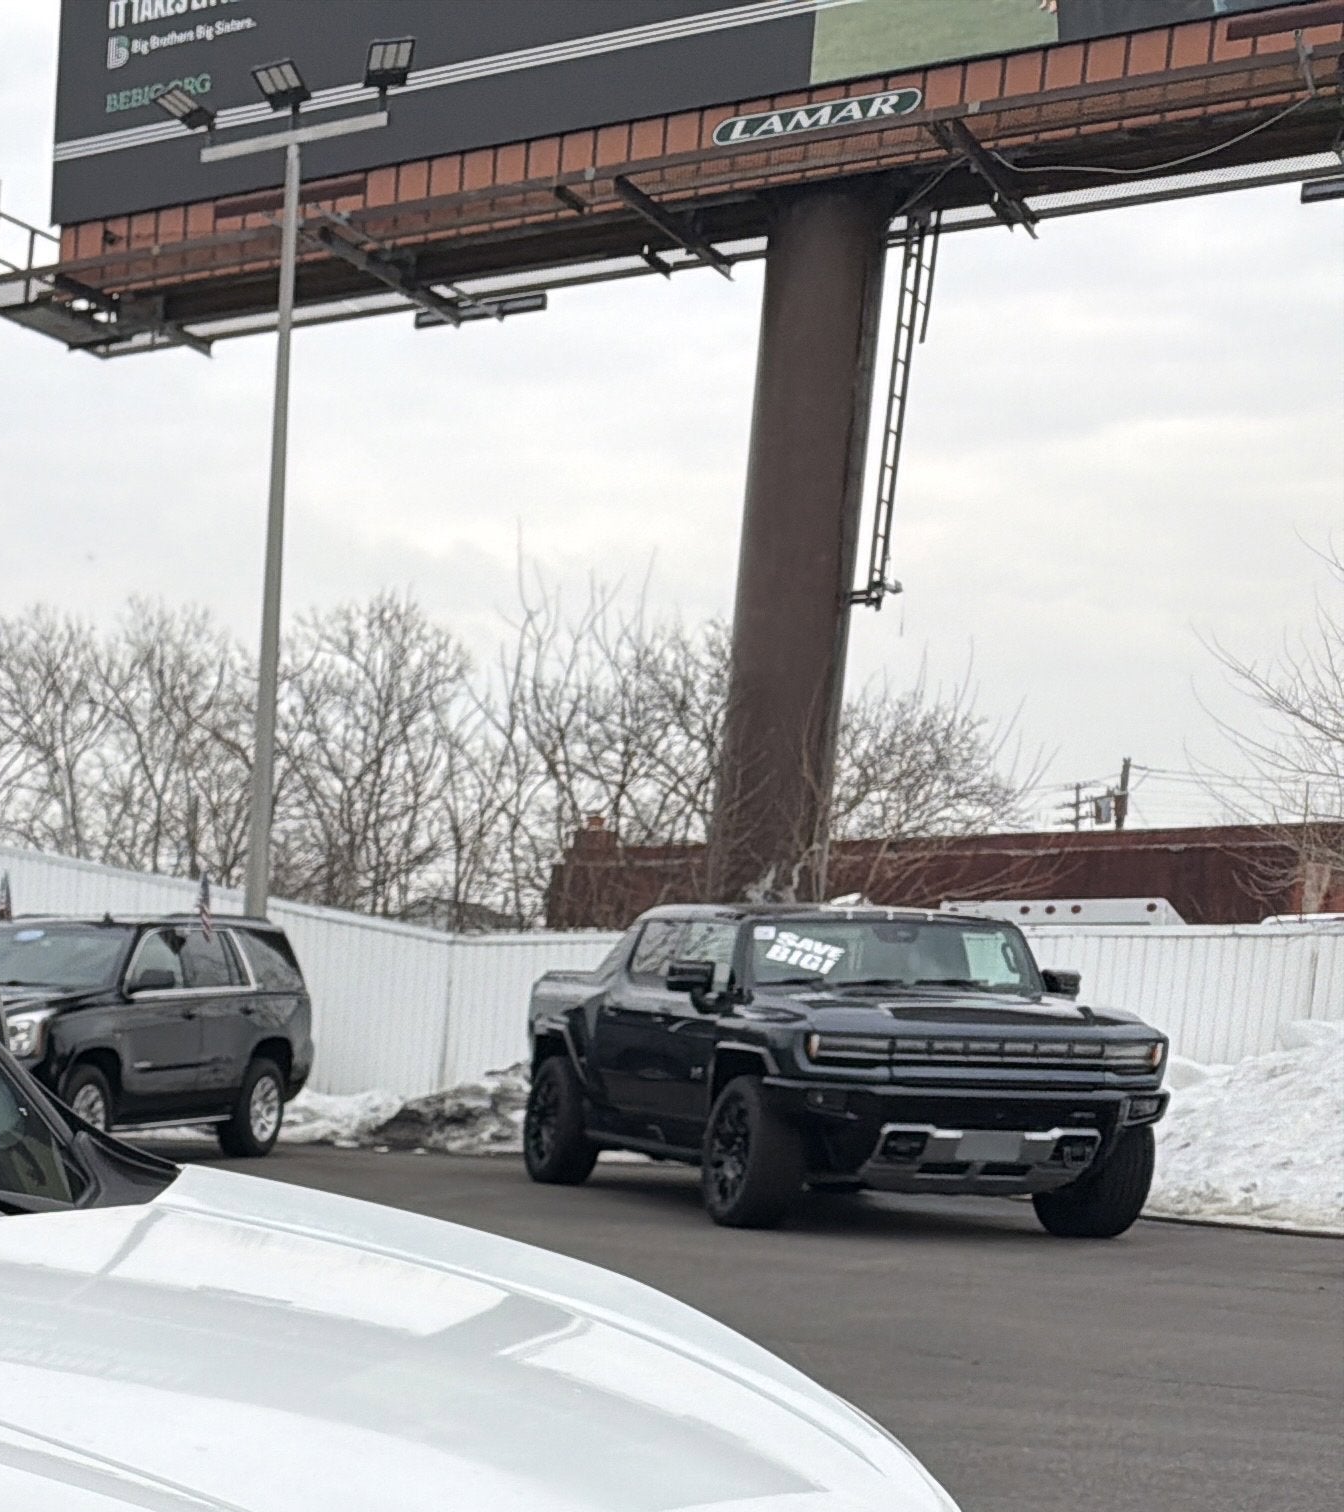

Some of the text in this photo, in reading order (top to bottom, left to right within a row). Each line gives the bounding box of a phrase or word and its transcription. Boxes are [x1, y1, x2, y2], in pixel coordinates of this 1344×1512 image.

[130, 38, 150, 56] Big
[149, 29, 195, 50] Brothers
[195, 23, 214, 41] Big
[729, 94, 900, 141] LAMAR
[775, 931, 846, 961] SAVE
